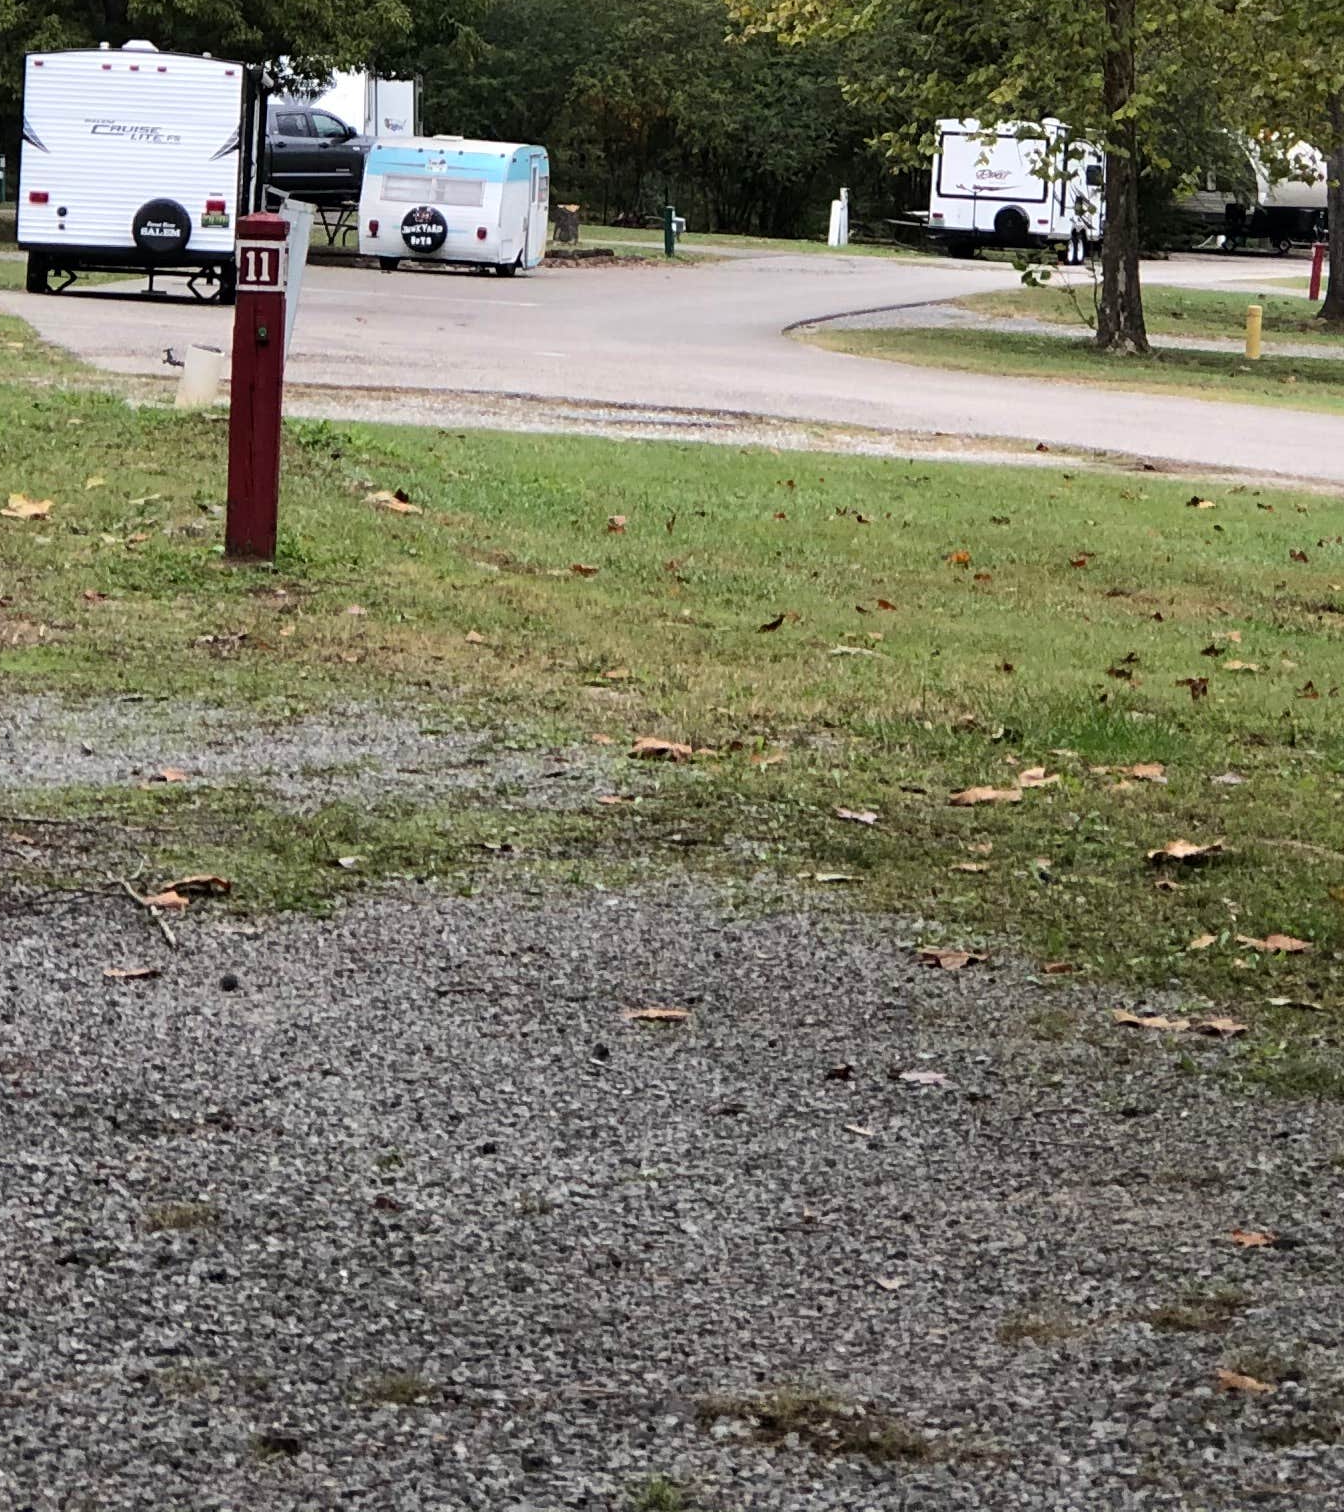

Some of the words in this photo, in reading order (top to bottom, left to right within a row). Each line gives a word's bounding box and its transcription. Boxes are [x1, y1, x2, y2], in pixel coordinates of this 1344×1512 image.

[91, 124, 161, 136] CRUISE
[130, 133, 165, 145] LITE
[140, 227, 181, 238] SALEM
[246, 250, 271, 282] 11
